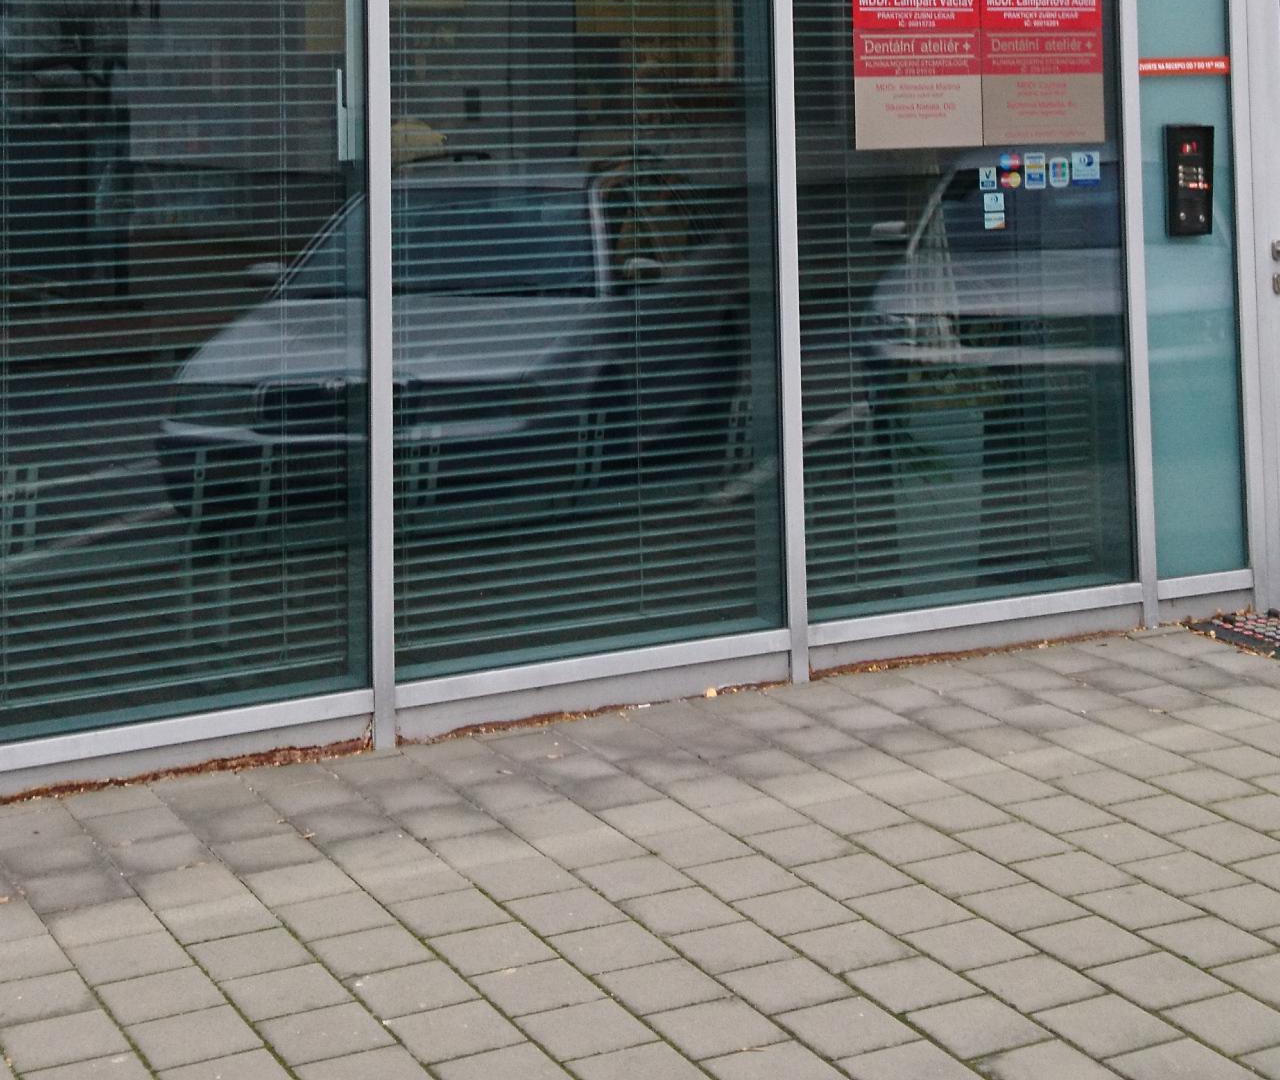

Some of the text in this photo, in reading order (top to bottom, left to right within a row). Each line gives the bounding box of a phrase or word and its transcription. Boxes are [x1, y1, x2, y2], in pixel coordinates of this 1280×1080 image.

[864, 39, 915, 54] Dentální
[920, 38, 959, 53] ateliér
[991, 38, 1039, 52] Dentální
